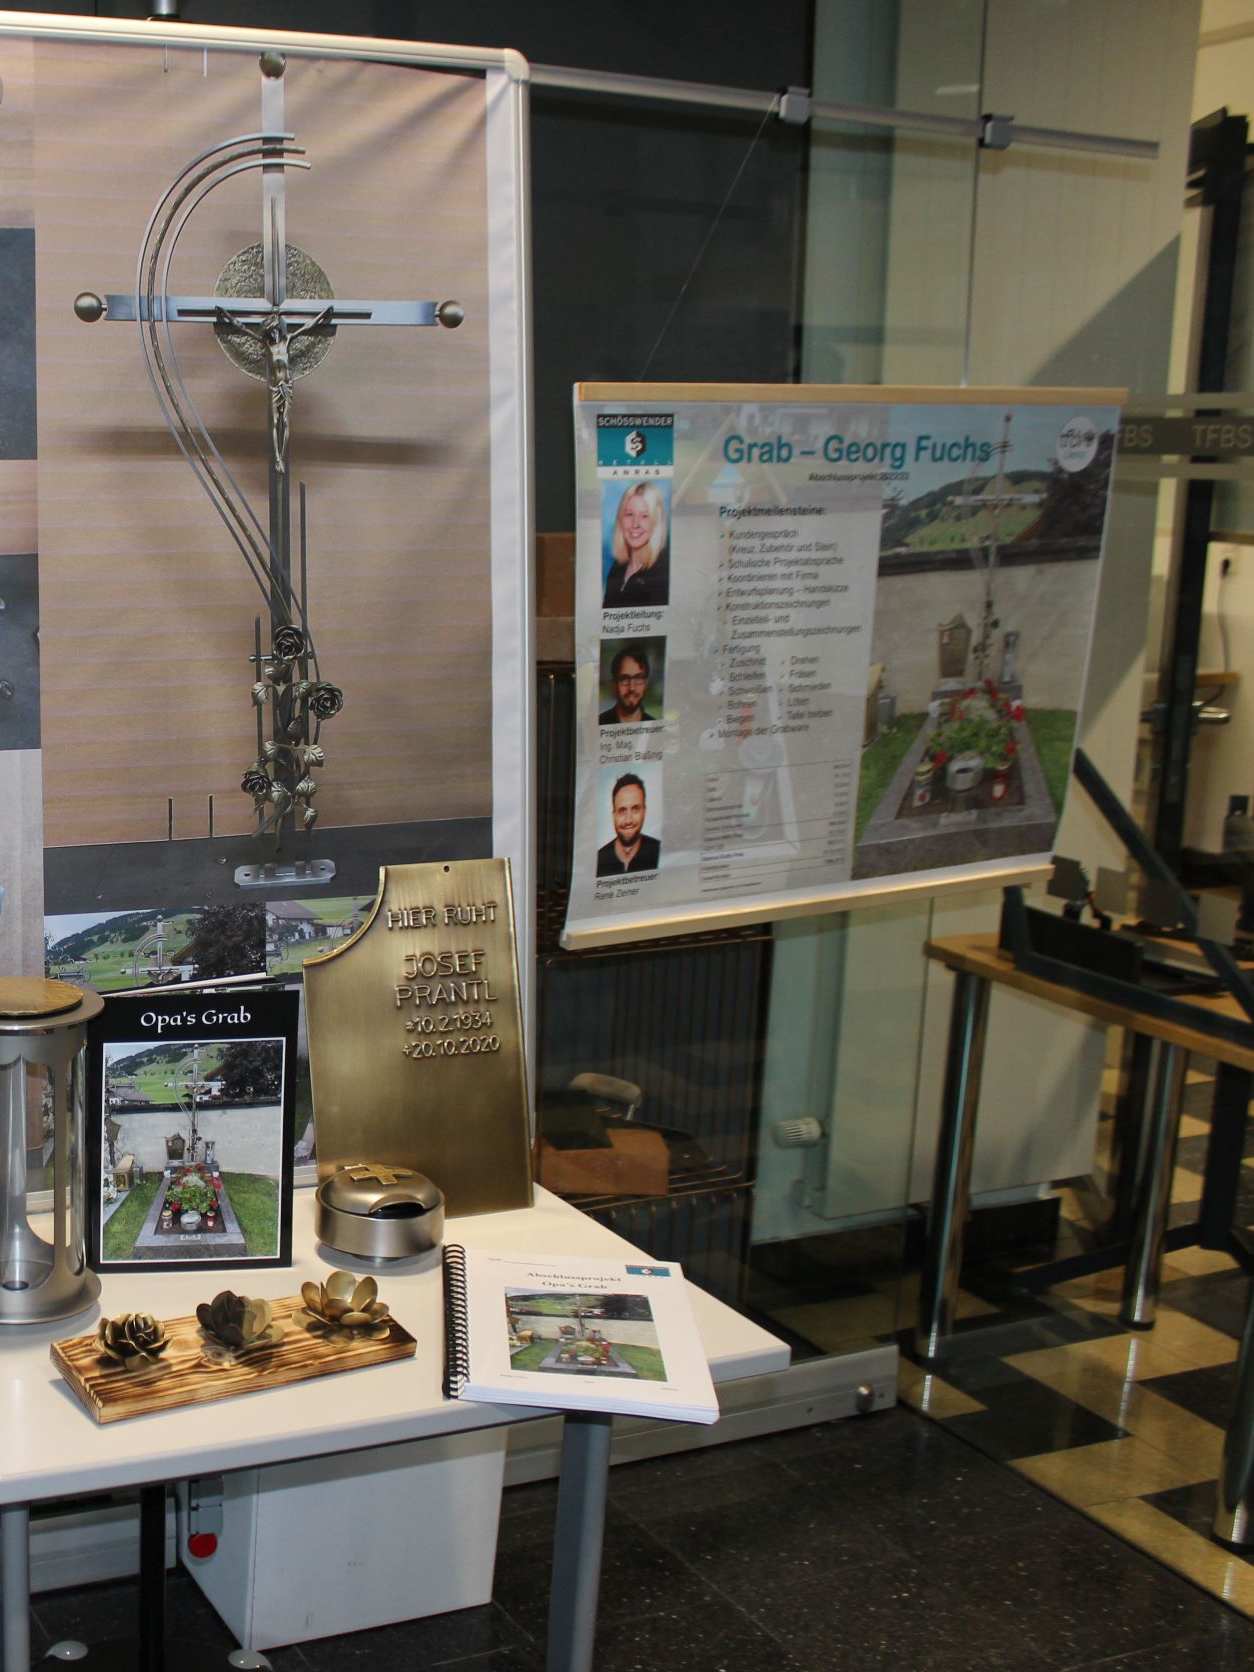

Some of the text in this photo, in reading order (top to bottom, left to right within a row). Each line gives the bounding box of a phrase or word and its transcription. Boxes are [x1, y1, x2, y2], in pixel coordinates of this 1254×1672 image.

[598, 415, 672, 426] SCHÖSSWENDER
[1192, 423, 1252, 449] TFBS
[723, 434, 793, 464] Grab
[823, 434, 907, 470] Georg
[914, 434, 991, 463] Fuchs
[627, 623, 651, 632] Fuchs
[387, 900, 497, 929] HIER RUHT
[403, 949, 486, 980] JOSEF
[394, 979, 499, 1008] PRANTL
[140, 1005, 252, 1034] Opa's Grab
